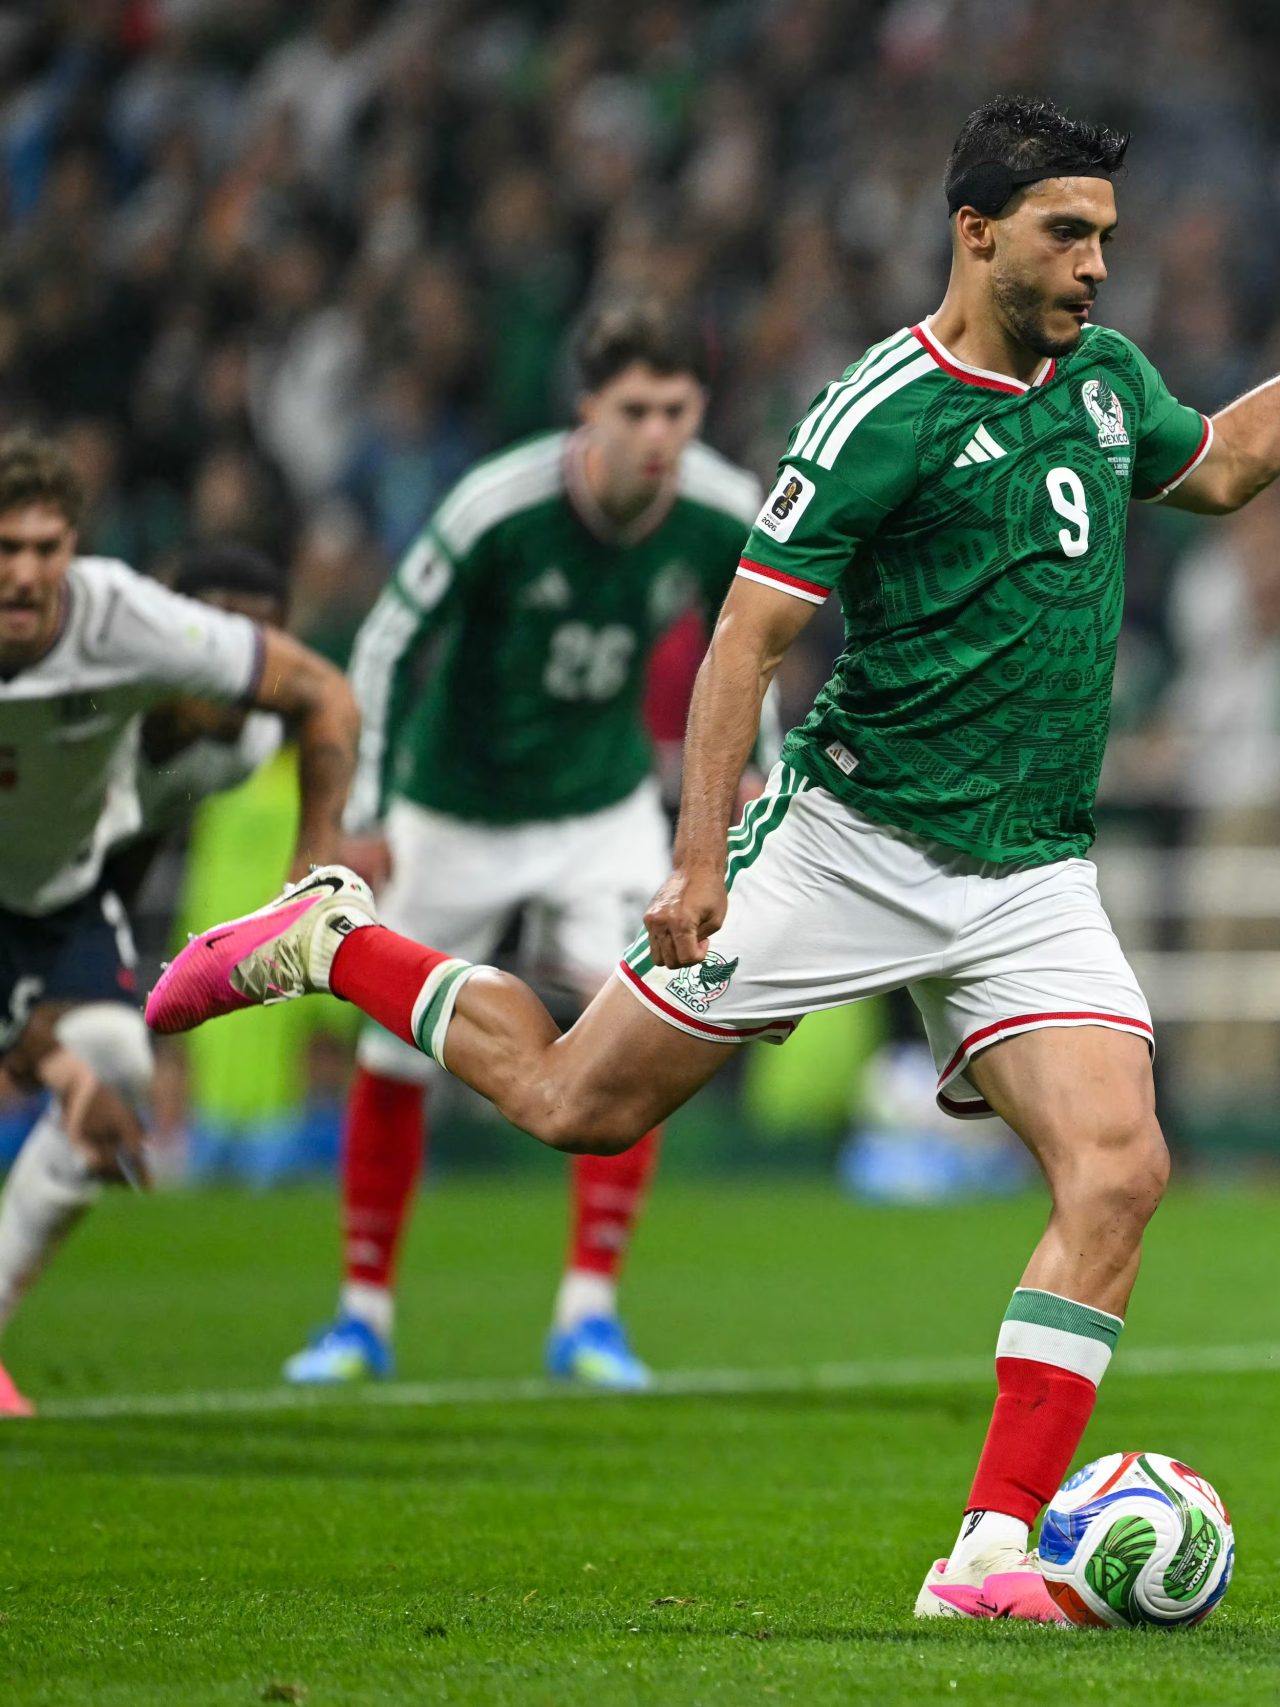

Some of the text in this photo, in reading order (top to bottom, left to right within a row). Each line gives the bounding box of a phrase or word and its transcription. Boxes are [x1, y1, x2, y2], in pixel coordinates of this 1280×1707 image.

[1100, 433, 1128, 446] MÉXICO
[761, 516, 778, 532] 2026
[1046, 467, 1089, 557] 9
[669, 981, 705, 1013] MÉXICO
[1185, 1538, 1217, 1591] TRIONDA
